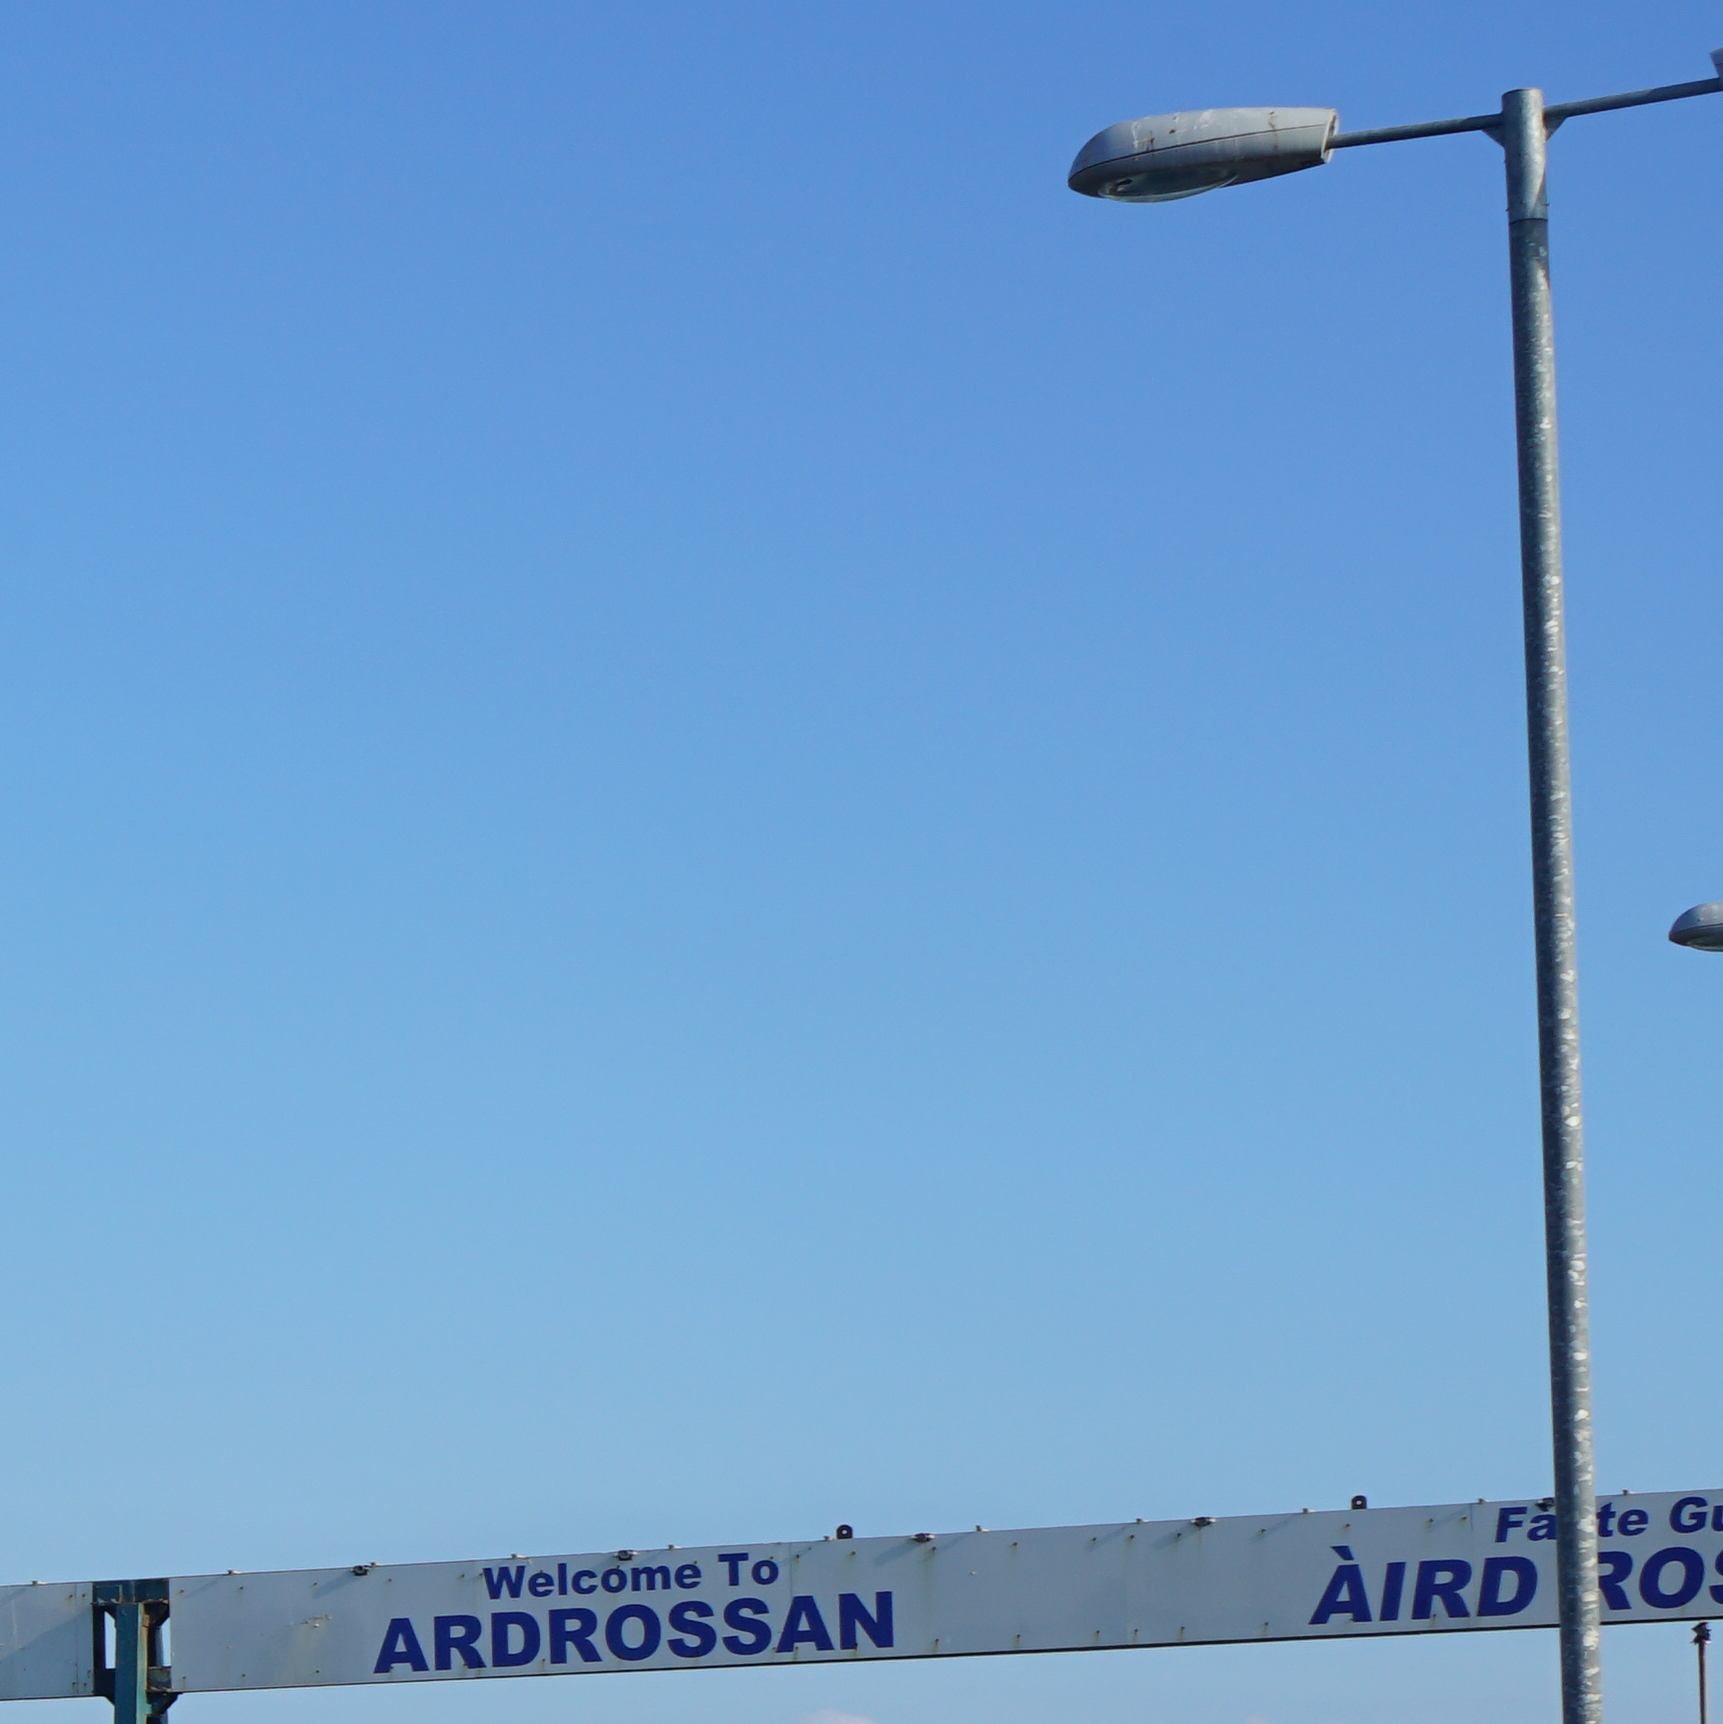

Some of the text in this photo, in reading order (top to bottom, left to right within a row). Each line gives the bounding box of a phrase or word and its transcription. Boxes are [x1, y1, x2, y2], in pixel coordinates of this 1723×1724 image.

[483, 1552, 779, 1600] Welcome To
[1308, 1545, 1538, 1626] ÀIRD
[374, 1590, 896, 1674] ARDROSSAN
